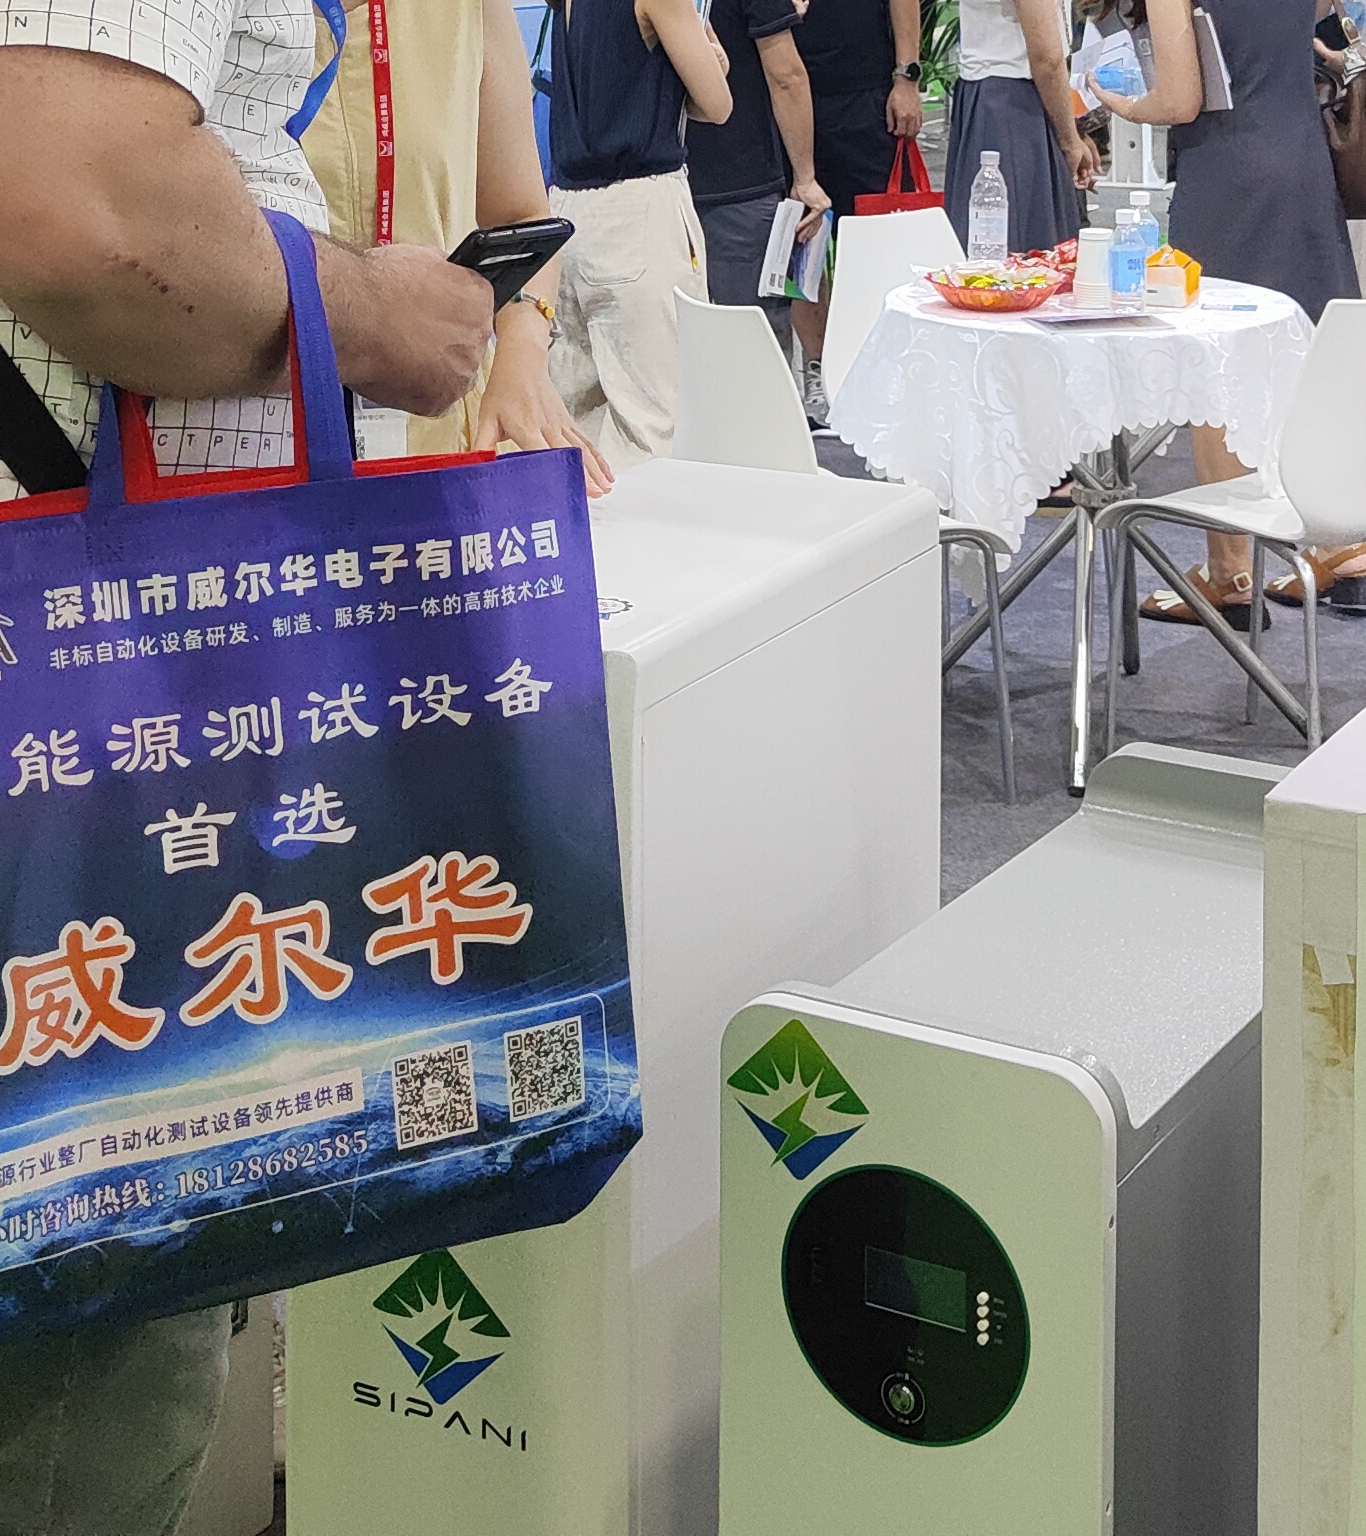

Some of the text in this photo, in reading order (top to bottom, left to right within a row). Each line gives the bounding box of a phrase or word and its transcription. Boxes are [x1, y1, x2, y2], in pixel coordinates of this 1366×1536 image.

[43, 519, 561, 631] 深圳市威尔华电子有限公司
[143, 782, 357, 875] 首选
[352, 1380, 528, 1452] SIPANI
